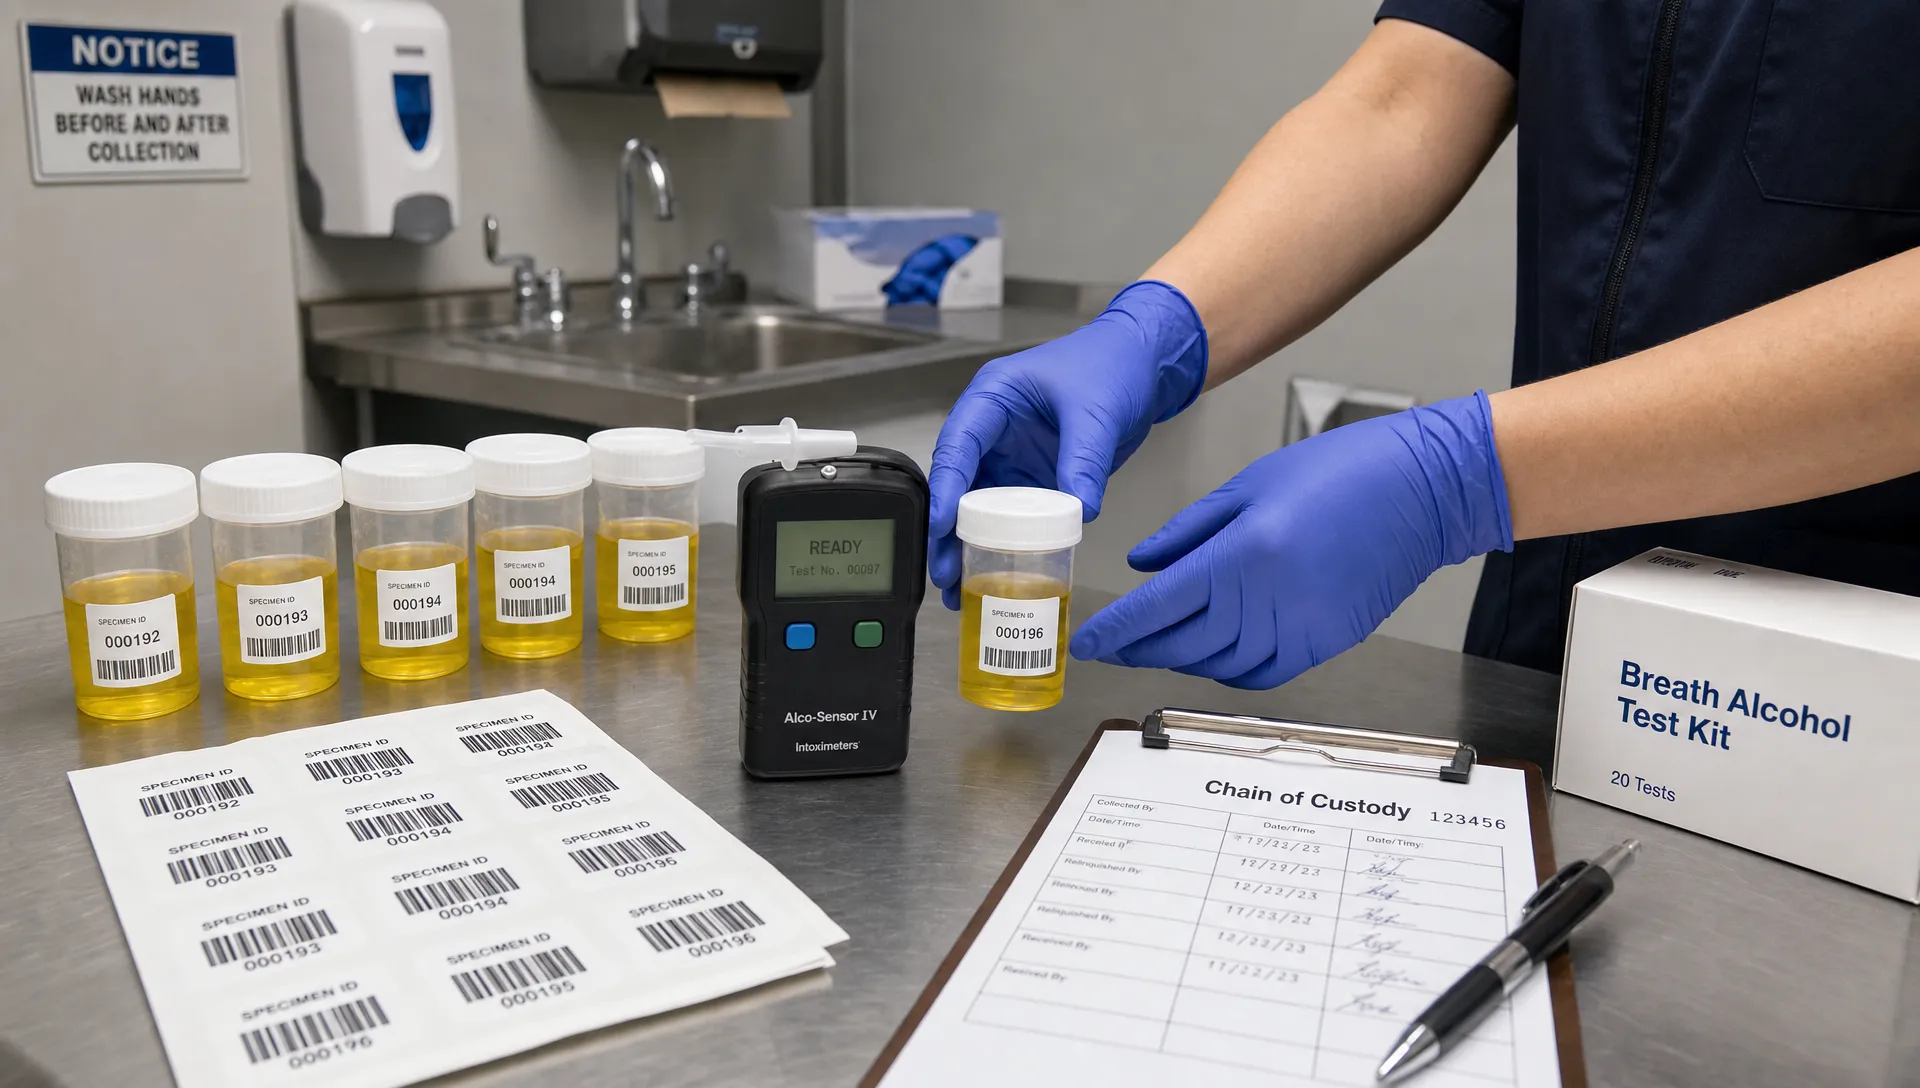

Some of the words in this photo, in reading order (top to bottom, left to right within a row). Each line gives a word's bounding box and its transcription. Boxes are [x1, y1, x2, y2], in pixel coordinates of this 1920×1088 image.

[72, 35, 200, 69] NOTICE
[77, 85, 131, 105] WASH
[138, 86, 200, 106] HANDS
[55, 114, 127, 134] BEFORE
[133, 115, 171, 134] AND
[175, 115, 230, 134] AFTER
[88, 141, 200, 162] COLLECTION
[809, 540, 863, 555] READY
[503, 561, 537, 569] SPECIMEN
[632, 564, 676, 578] 000195
[790, 565, 817, 576] Test
[821, 565, 841, 576] No.
[847, 564, 880, 576] 00097
[387, 582, 422, 590] SPECIMEN
[508, 575, 556, 589] 000194
[248, 597, 286, 605] SPECIMEN
[393, 595, 442, 611] 000194
[98, 617, 137, 626] SPECIMEN
[138, 615, 147, 623] ID
[255, 609, 308, 627] 000193
[991, 609, 1026, 619] SPECIMEN
[105, 630, 161, 649] 000192
[995, 626, 1044, 640] 000196
[1621, 659, 1720, 709] Breath
[1727, 689, 1852, 742] Alcohol
[455, 716, 519, 734] SPECIMEN
[521, 713, 535, 721] ID
[784, 711, 859, 724] Alco-Sensor
[861, 709, 878, 721] IV
[1617, 696, 1680, 737] Test
[1688, 716, 1731, 750] Kit
[304, 741, 373, 759] SPECIMEN
[375, 738, 390, 747] ID
[795, 741, 860, 753] Intoximeters
[140, 771, 215, 793] SPECIMEN
[218, 768, 234, 777] ID
[342, 768, 403, 786] 000193
[505, 766, 570, 785] SPECIMEN
[573, 763, 588, 772] ID
[1610, 770, 1630, 788] 20
[1634, 776, 1676, 802] Tests
[173, 799, 241, 821] 000192
[344, 796, 417, 816] SPECIMEN
[420, 792, 435, 802] ID
[552, 794, 612, 814] 000195
[1097, 799, 1140, 810] Collected
[1205, 780, 1272, 802] Chain
[1280, 791, 1305, 805] of
[1310, 793, 1411, 821] Custody
[1263, 822, 1316, 834] Date/Time
[1430, 811, 1506, 830] 123456
[168, 830, 251, 855] SPECIMEN
[253, 826, 269, 836] ID
[386, 826, 452, 846] 000194
[561, 823, 633, 846] SPECIMEN
[635, 820, 651, 829] ID
[206, 863, 278, 888] 000193
[391, 860, 470, 884] SPECIMEN
[473, 855, 489, 865] ID
[614, 857, 678, 878] 000196
[438, 895, 509, 921] 000194
[629, 892, 704, 919] SPECIMEN
[707, 888, 724, 899] ID
[201, 902, 289, 932] SPECIMEN
[292, 897, 310, 907] ID
[446, 937, 530, 966] SPECIMEN
[533, 932, 551, 943] ID
[688, 932, 757, 958] 000196
[243, 942, 322, 973] 000193
[241, 988, 336, 1023] SPECIMEN
[339, 980, 359, 993] ID
[500, 980, 576, 1010] 000195
